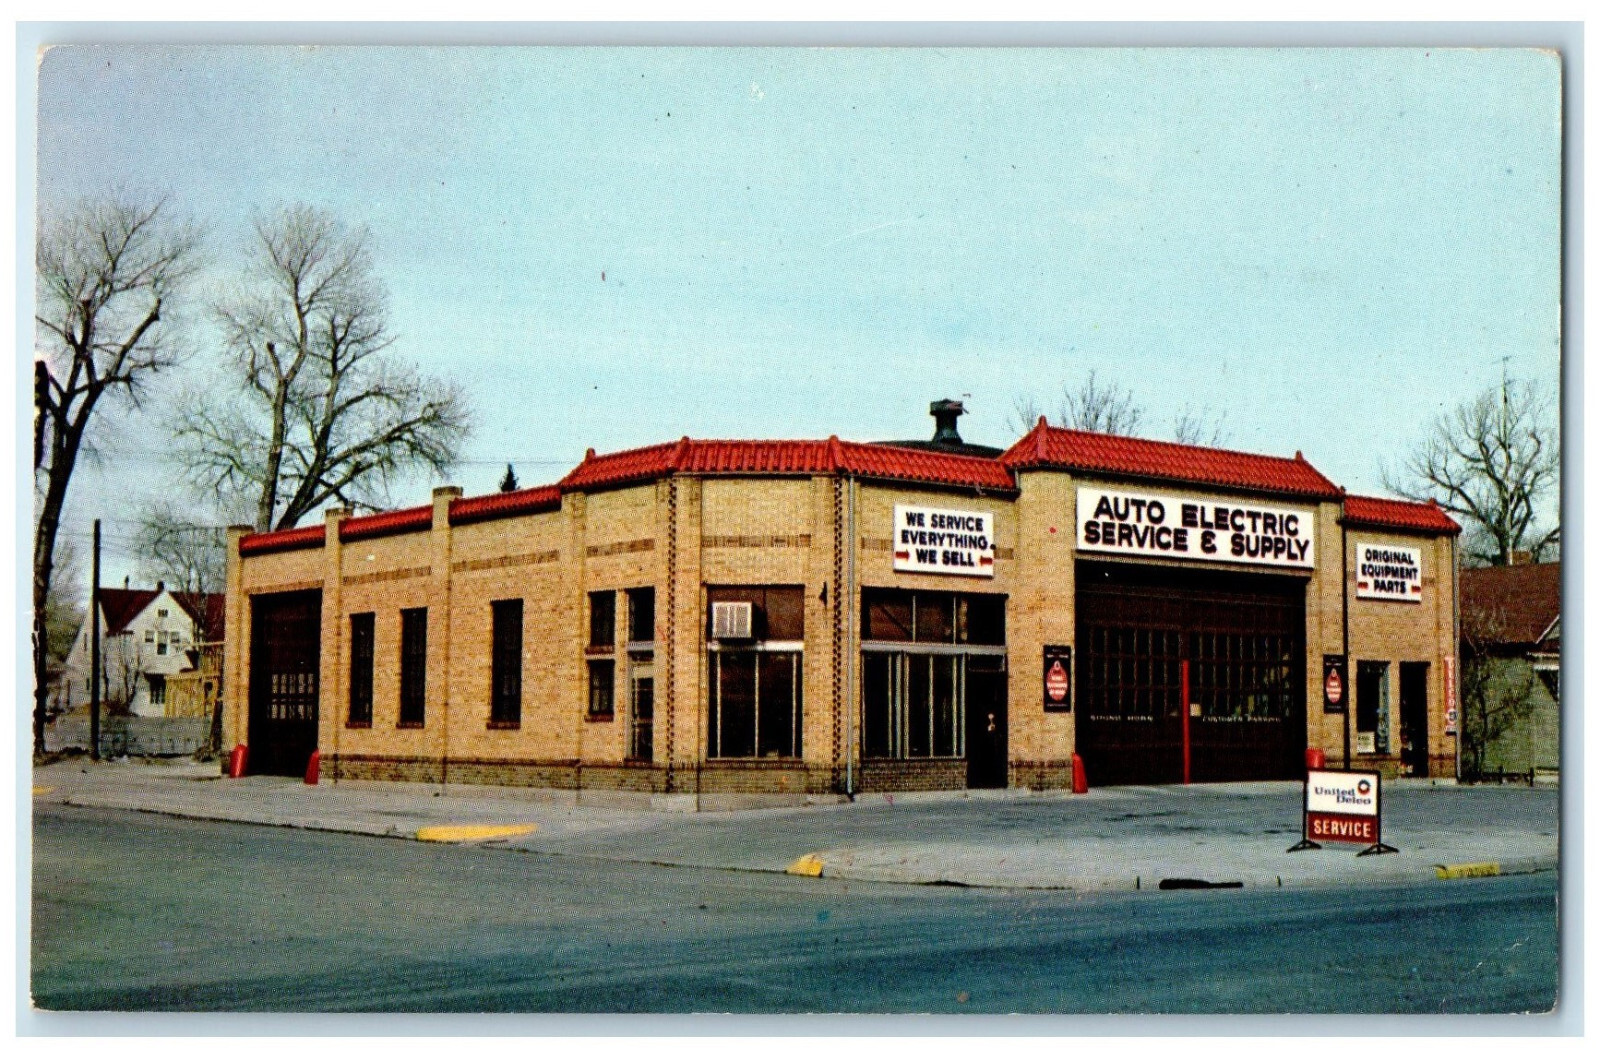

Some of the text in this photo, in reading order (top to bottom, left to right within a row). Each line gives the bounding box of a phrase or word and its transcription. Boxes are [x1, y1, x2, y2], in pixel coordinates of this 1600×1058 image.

[906, 512, 983, 532] WE SERVICE
[1093, 496, 1299, 536] AUTO ELECTRIC
[1084, 520, 1310, 561] SERVICE & SUPPLY
[916, 548, 975, 567] WE SELL
[1365, 548, 1414, 565] ORIGINAL
[1361, 563, 1418, 580] EQUIPMENT
[1374, 579, 1406, 594] PARTS
[1314, 786, 1355, 797] United
[1336, 794, 1371, 805] Delco
[1313, 819, 1371, 838] SERVICE
